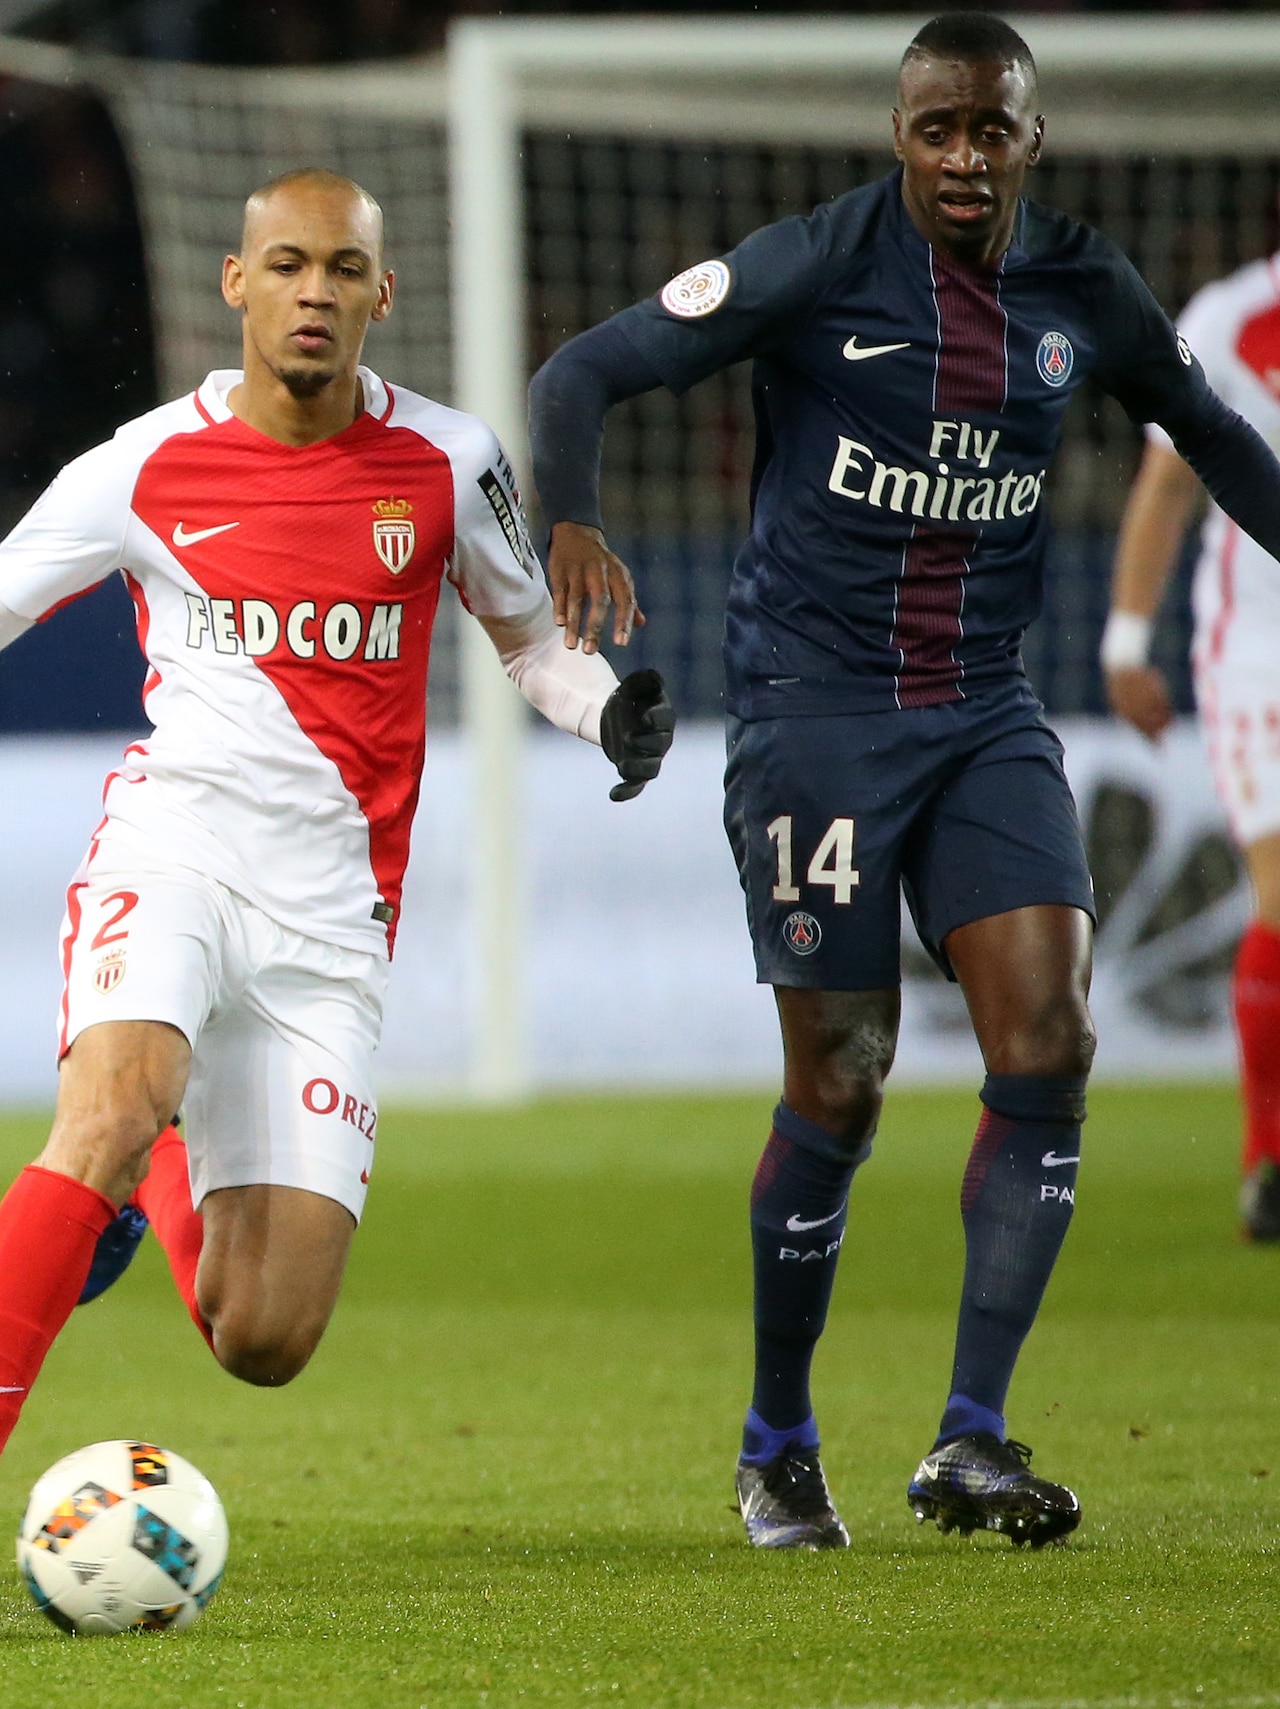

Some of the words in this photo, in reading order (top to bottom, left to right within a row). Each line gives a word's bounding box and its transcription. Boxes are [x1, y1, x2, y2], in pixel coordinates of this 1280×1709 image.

[1044, 335, 1068, 348] PARIS
[929, 420, 1000, 468] Fly
[828, 434, 1047, 521] Emirates
[184, 592, 403, 661] FEDCOM
[766, 814, 860, 904] 14
[90, 891, 139, 952] 2
[1040, 1184, 1075, 1206] PA
